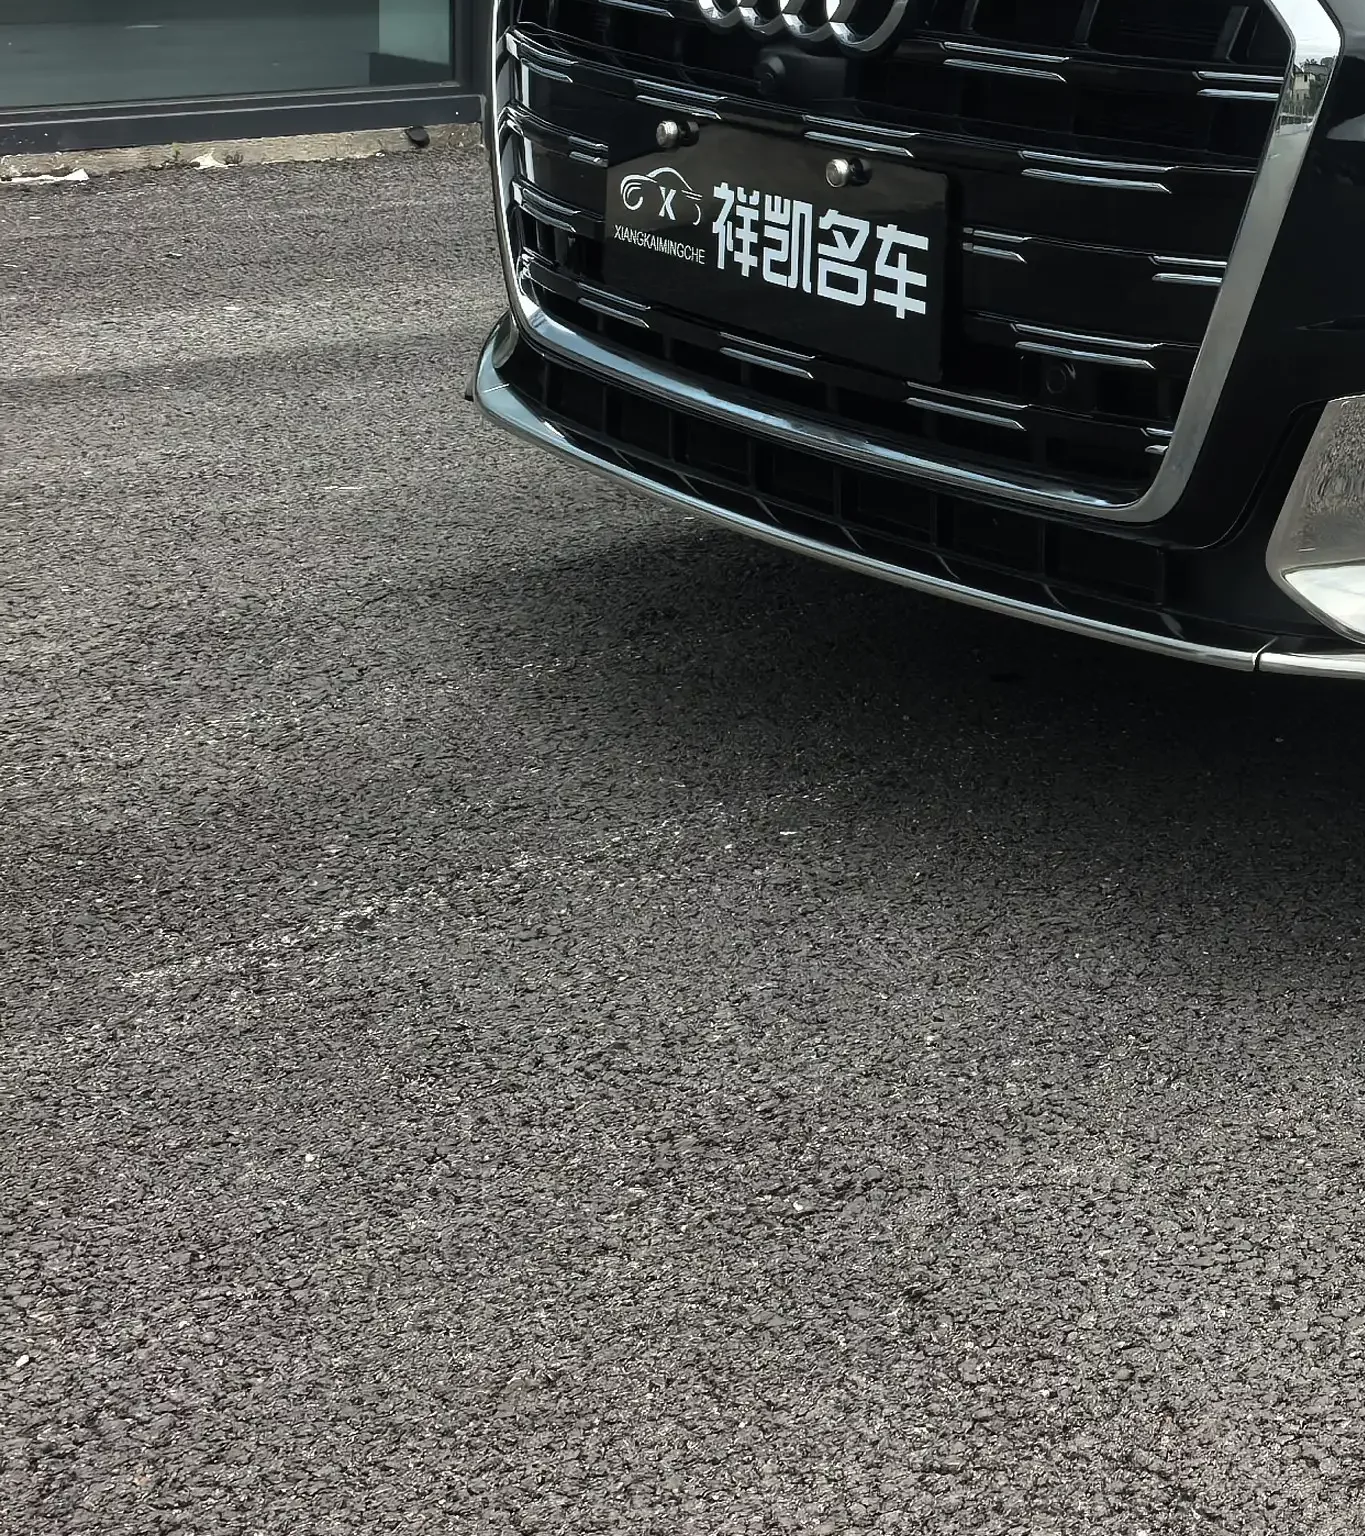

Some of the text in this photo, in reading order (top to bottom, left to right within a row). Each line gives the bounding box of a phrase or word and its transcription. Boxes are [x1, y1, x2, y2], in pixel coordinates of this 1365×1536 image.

[614, 224, 705, 264] XIANGKAIMINGCHE
[712, 182, 929, 319] 祥凯名车
